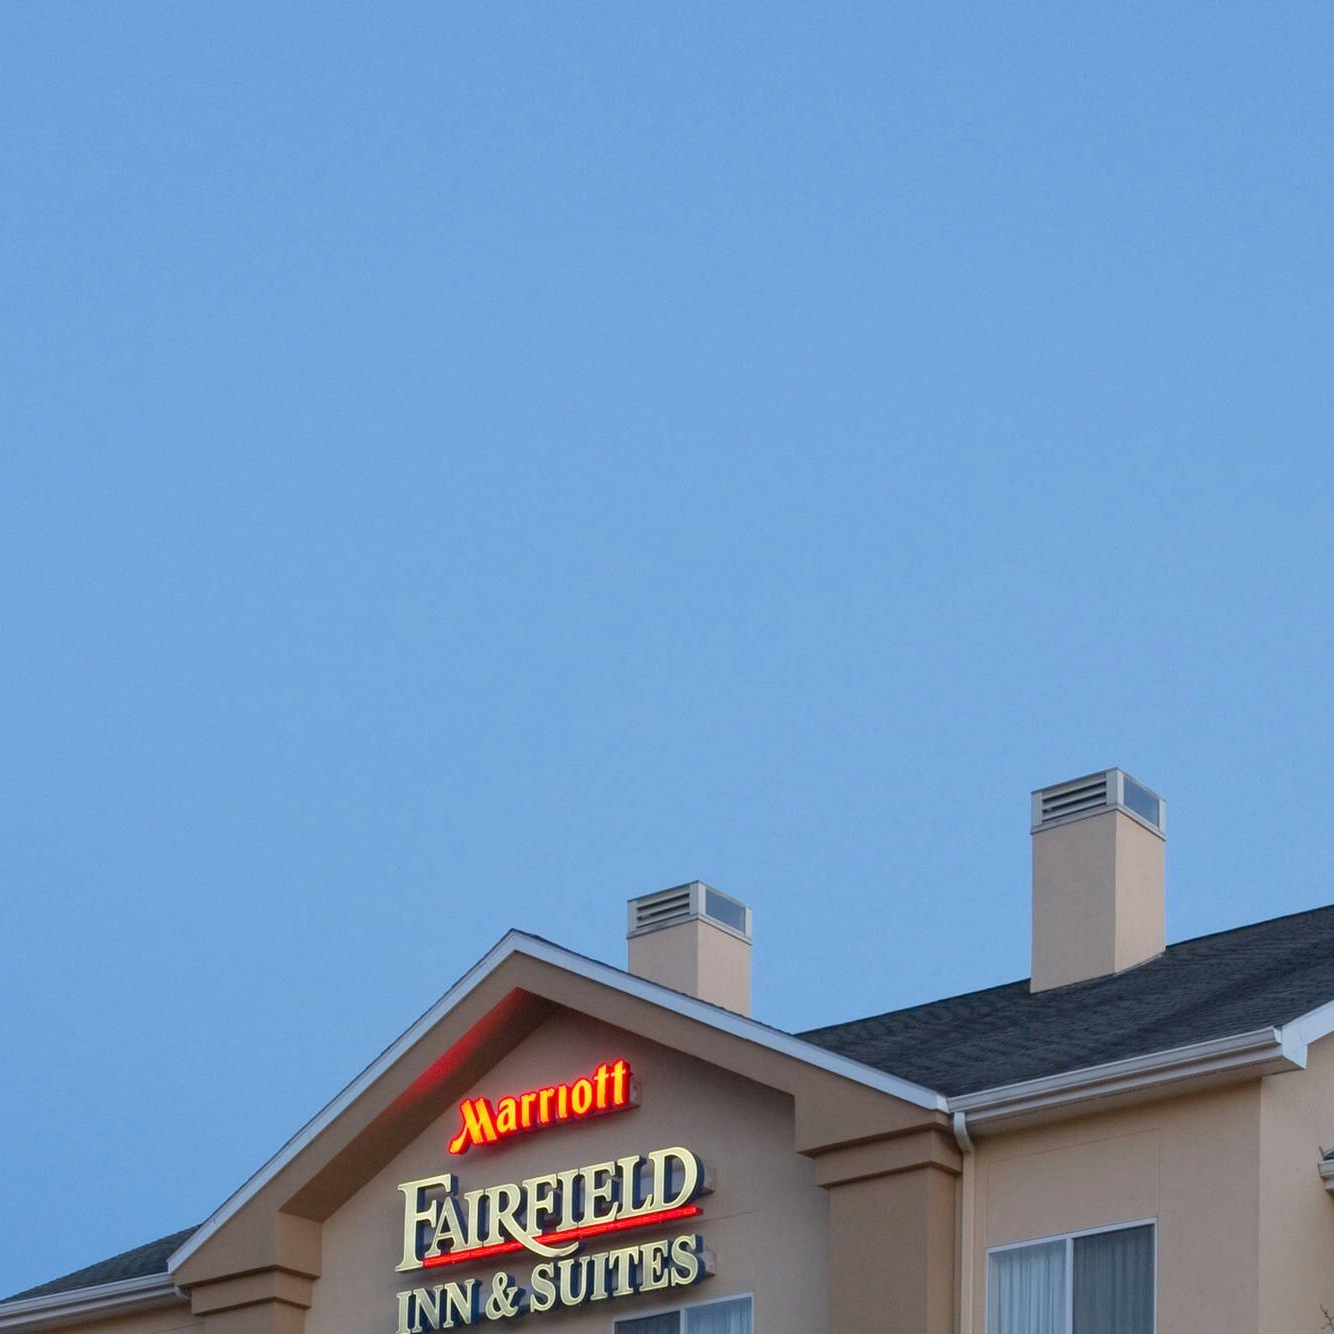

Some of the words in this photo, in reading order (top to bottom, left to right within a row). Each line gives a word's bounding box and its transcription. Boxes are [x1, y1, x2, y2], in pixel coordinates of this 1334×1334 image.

[448, 1059, 631, 1155] Marriott
[395, 1146, 700, 1272] FAIRFIELD
[485, 1272, 521, 1321] &
[530, 1234, 701, 1313] SUITES
